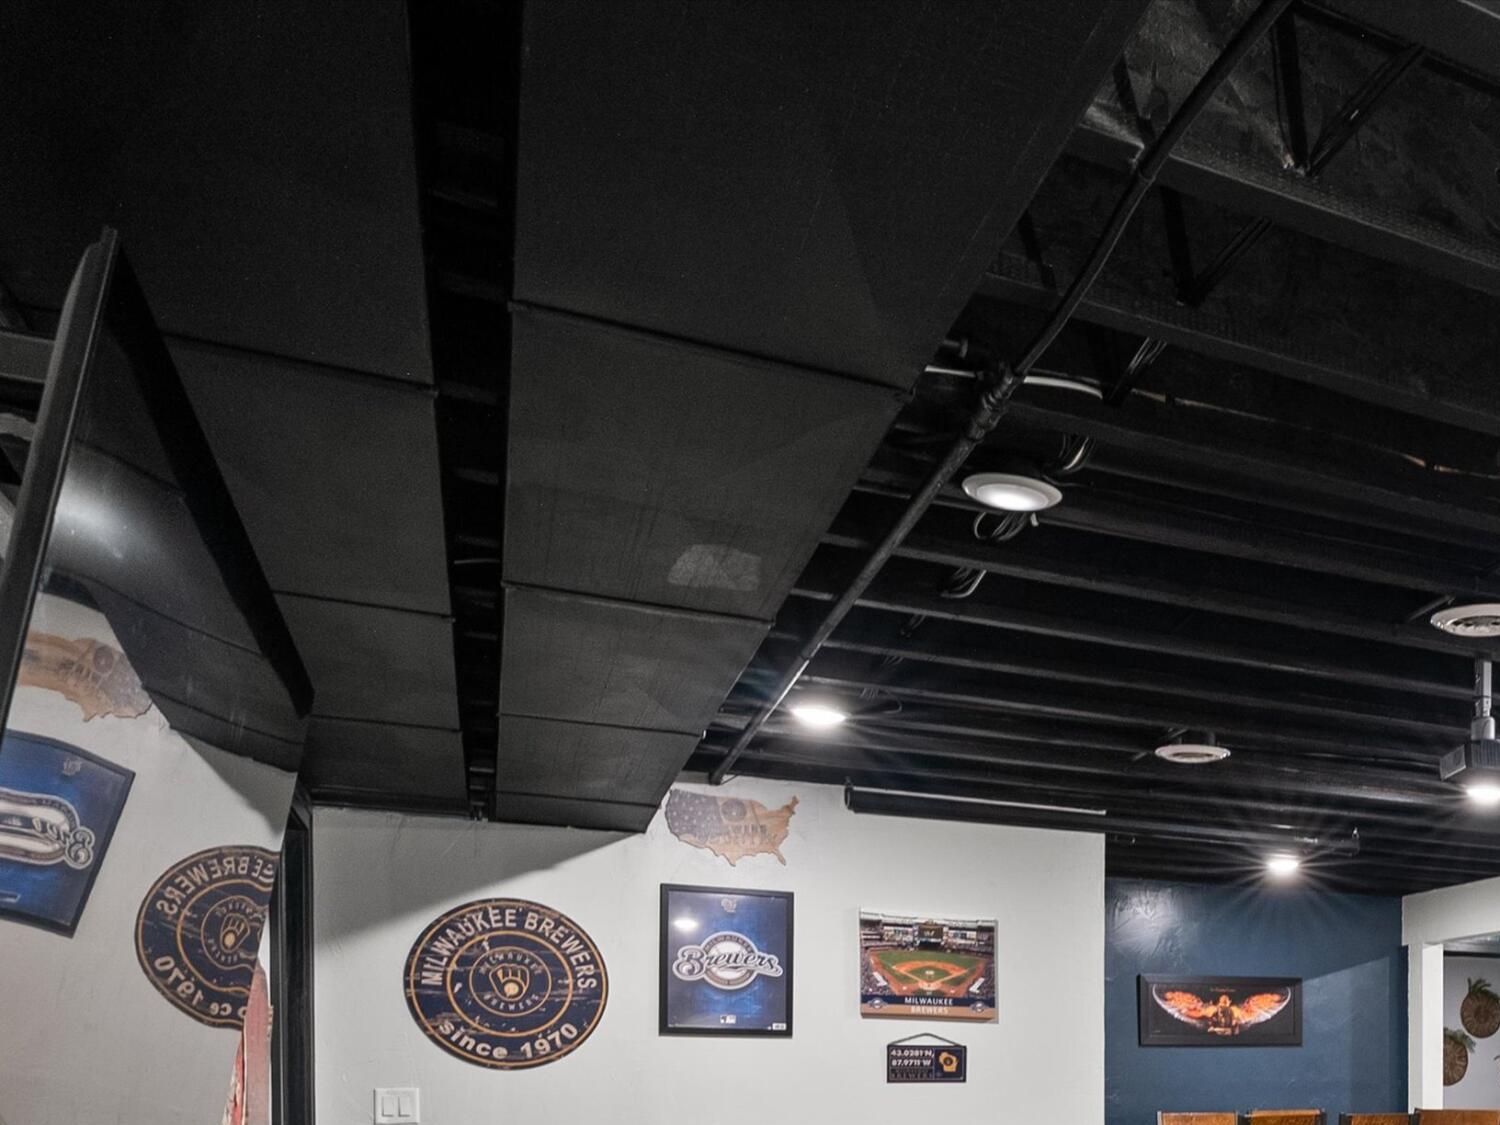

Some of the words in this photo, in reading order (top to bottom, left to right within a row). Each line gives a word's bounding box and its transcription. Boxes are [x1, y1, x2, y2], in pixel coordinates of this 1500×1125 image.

[421, 907, 517, 986] MILWAUKEE
[524, 911, 598, 989] BREWERS
[675, 946, 783, 979] Brewers
[904, 996, 954, 1006] MILWAUKEE
[438, 1021, 509, 1060] since
[520, 1023, 578, 1059] 1970
